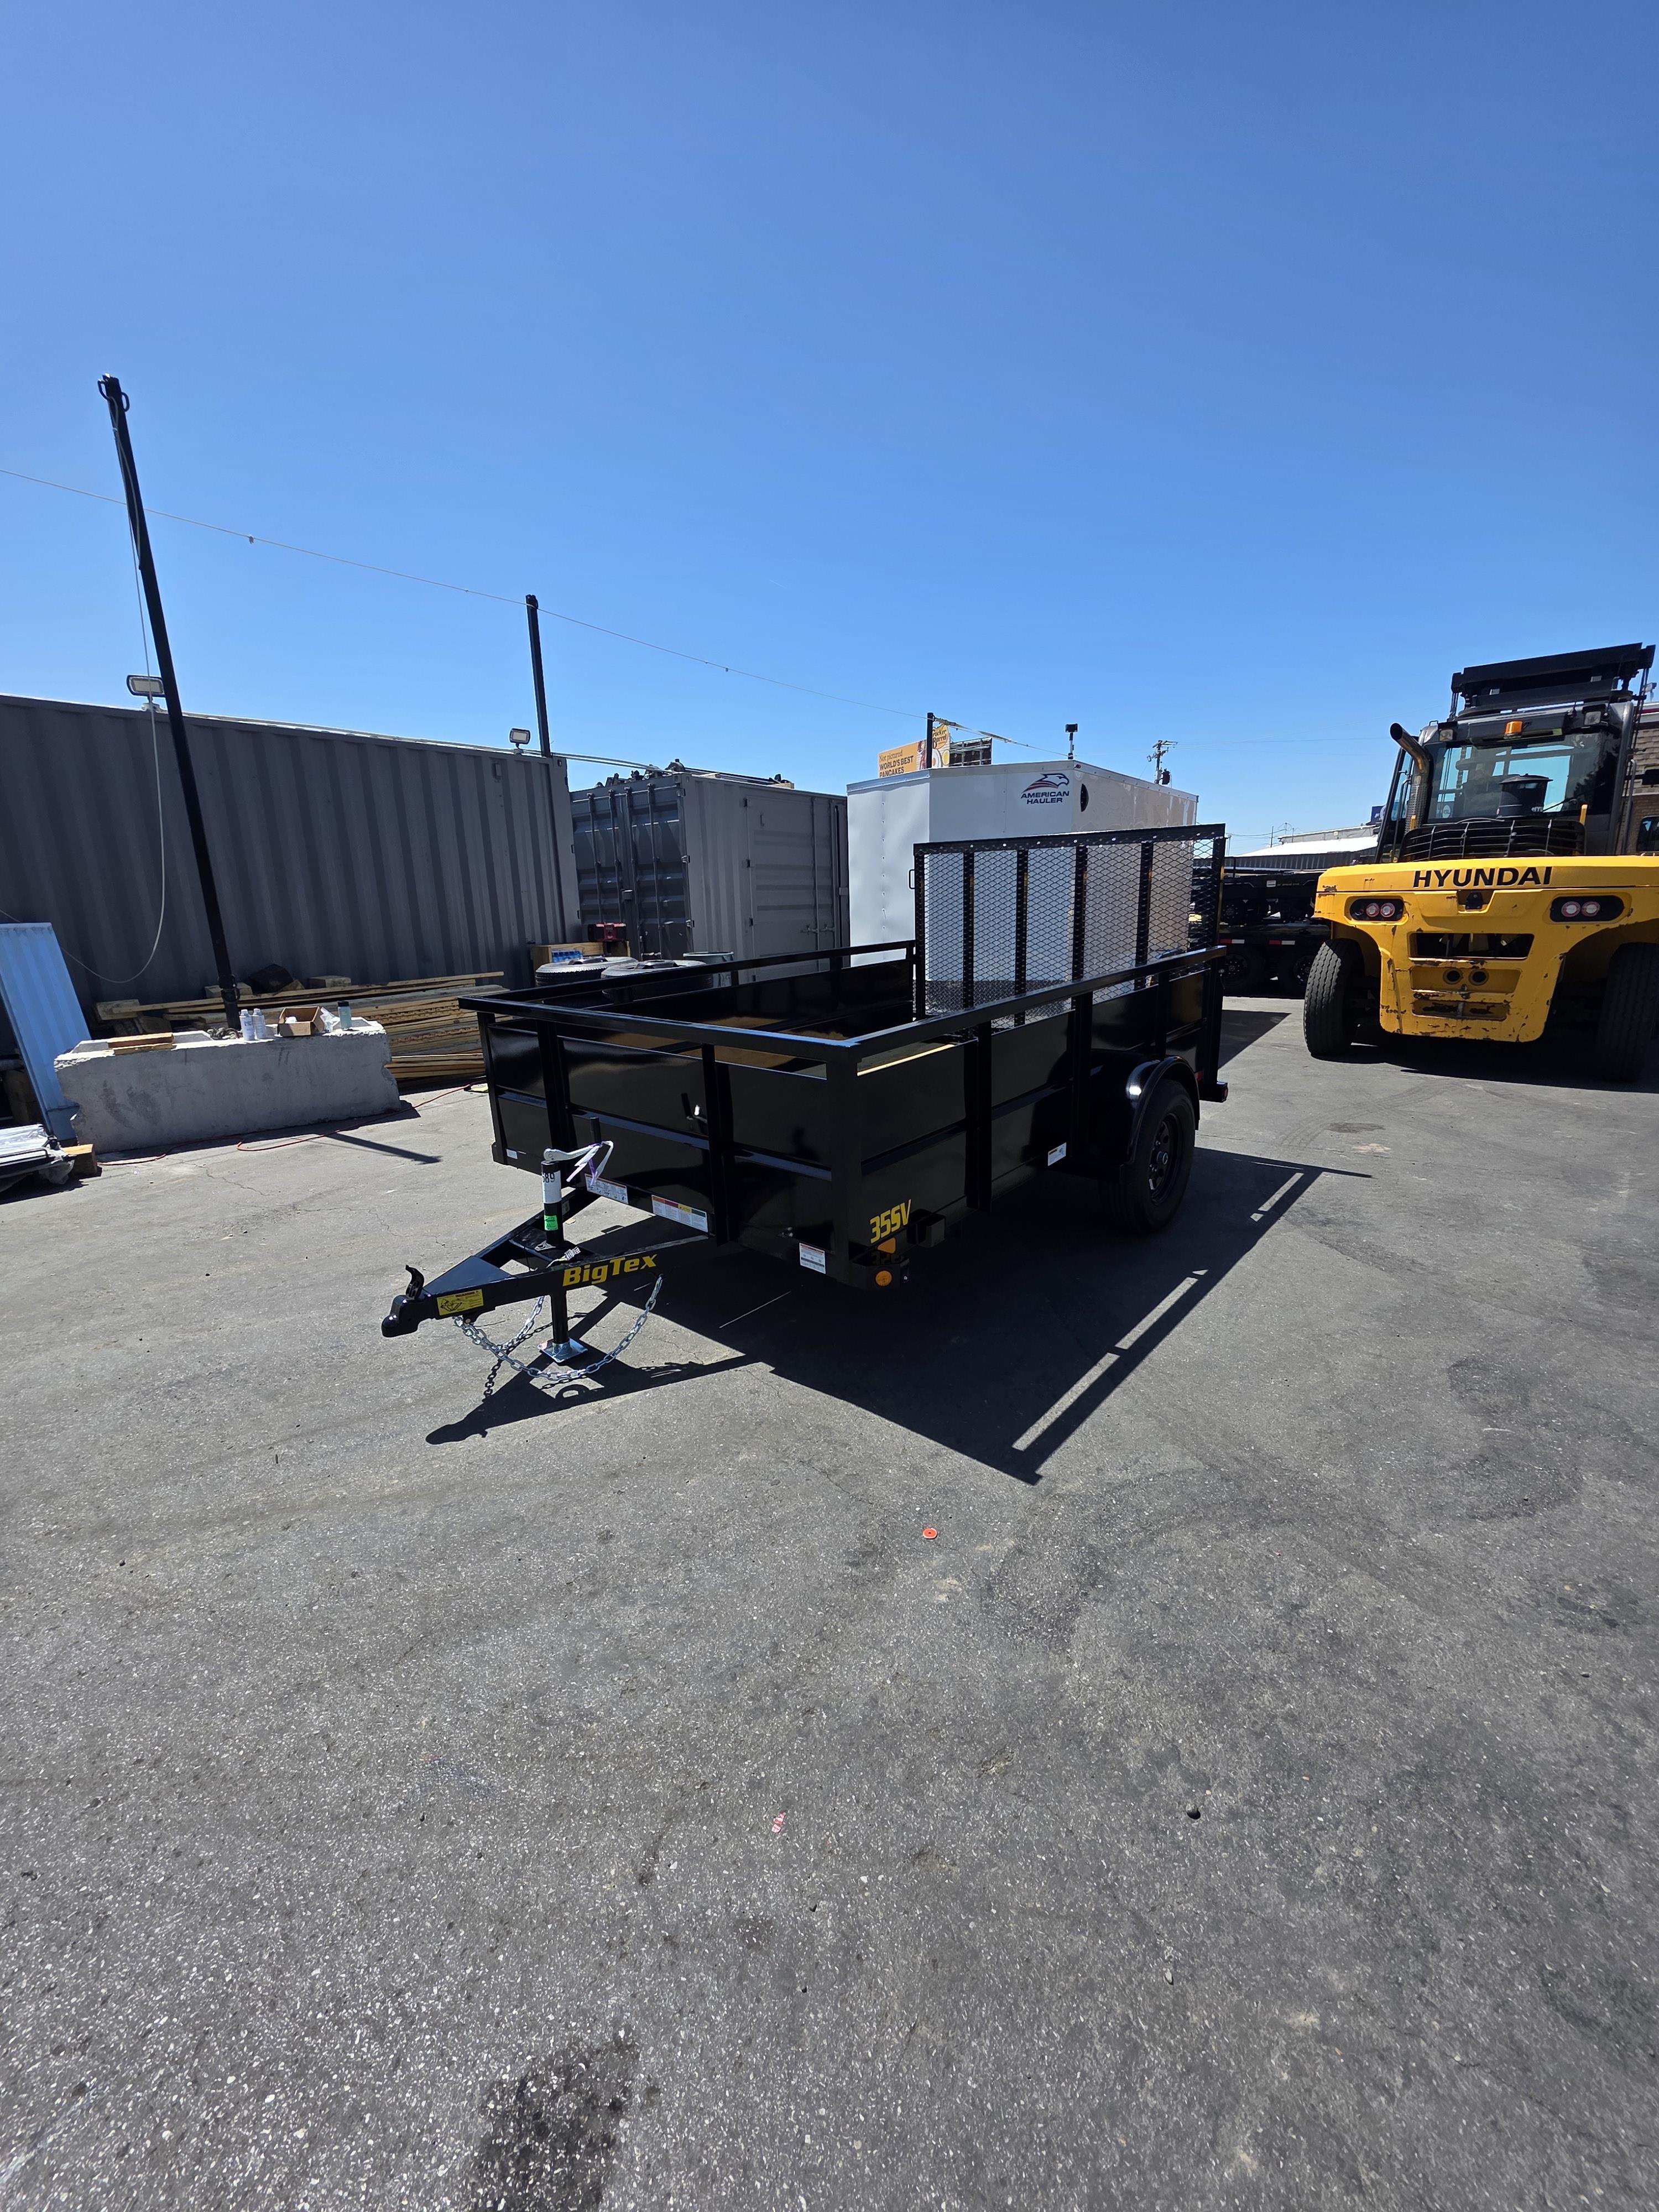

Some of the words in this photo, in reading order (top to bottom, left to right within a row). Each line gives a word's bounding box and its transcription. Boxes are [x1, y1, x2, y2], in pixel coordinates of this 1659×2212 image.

[932, 734, 947, 749] Barrel
[879, 759, 900, 770] WORLD'S
[901, 755, 914, 765] BEST
[887, 749, 903, 761] pictured
[879, 766, 905, 778] PANCAKES
[1413, 866, 1553, 888] HYUNDAI
[870, 1199, 911, 1244] 35SV
